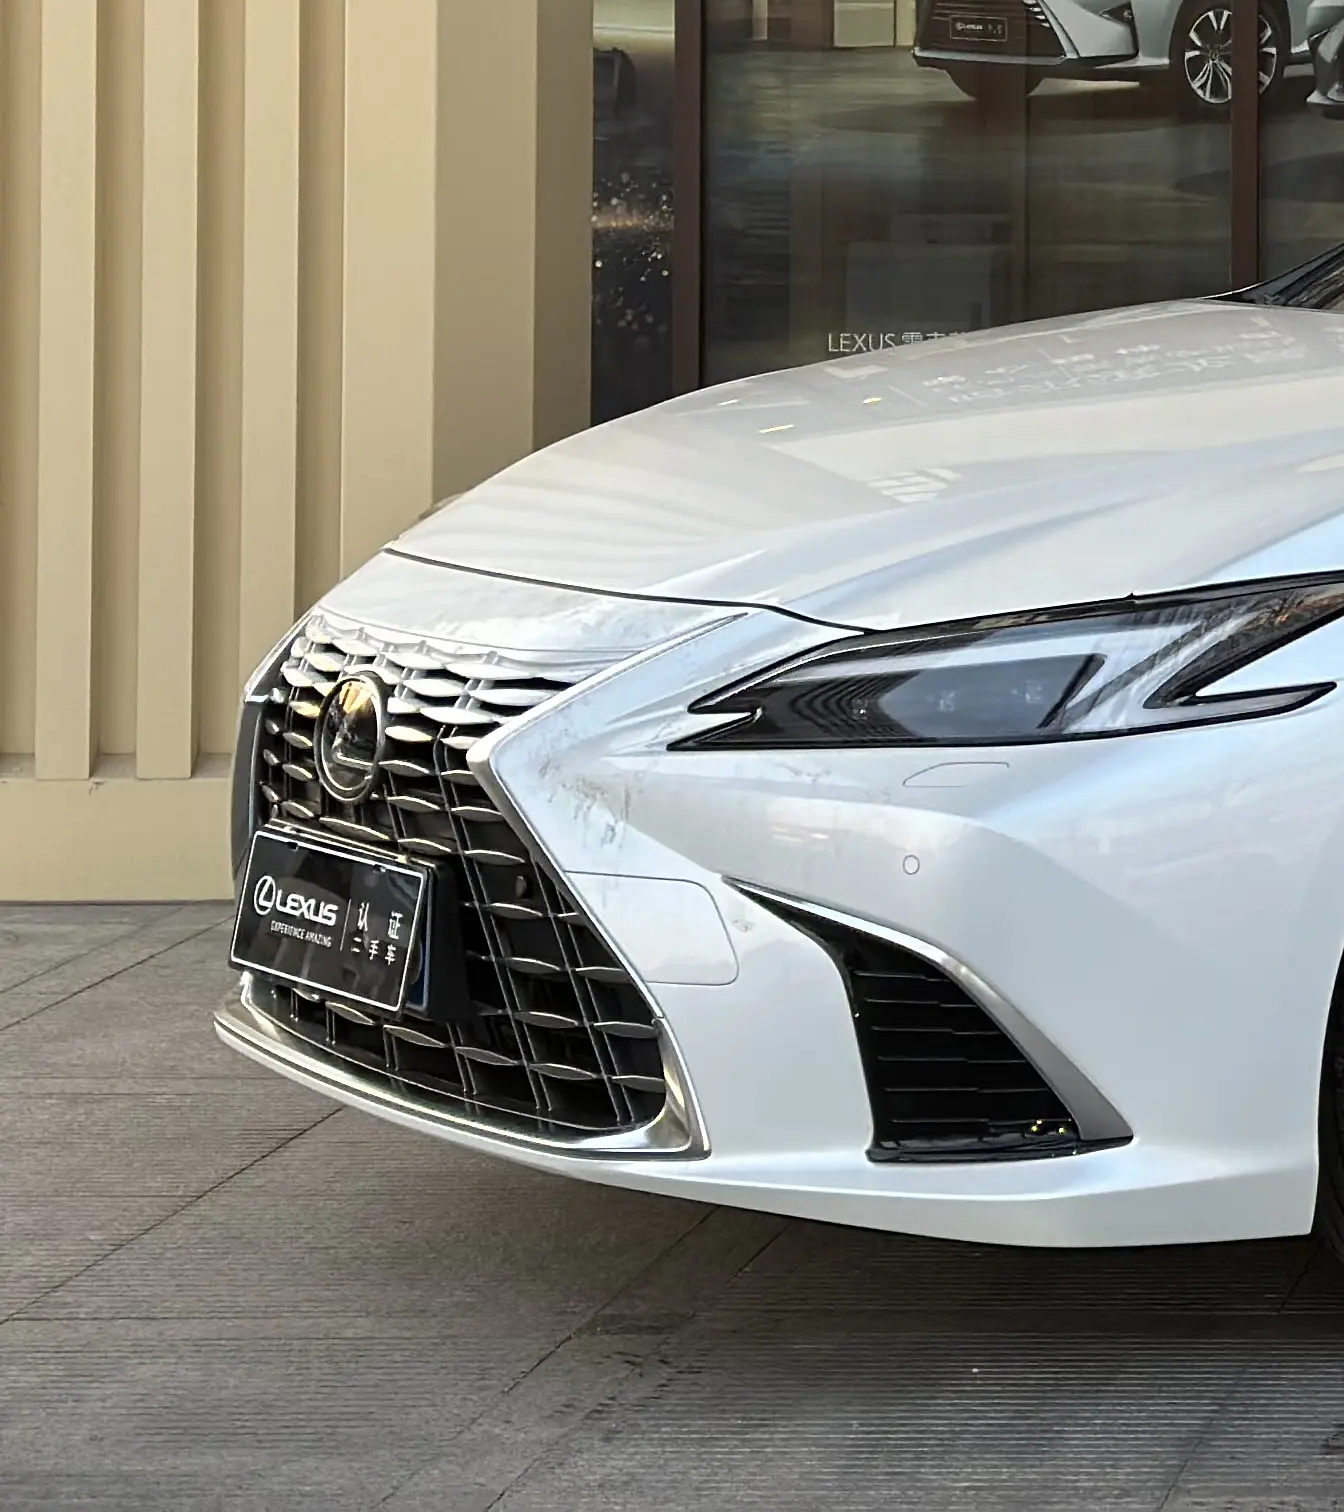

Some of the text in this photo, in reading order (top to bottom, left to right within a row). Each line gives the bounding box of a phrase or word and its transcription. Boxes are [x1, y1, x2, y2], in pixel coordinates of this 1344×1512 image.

[828, 333, 896, 352] LEXUS
[276, 890, 338, 926] LEXUS
[358, 902, 403, 939] 认证
[271, 920, 332, 947] EXPERIENCE AMAZING
[351, 937, 396, 965] 二手车
